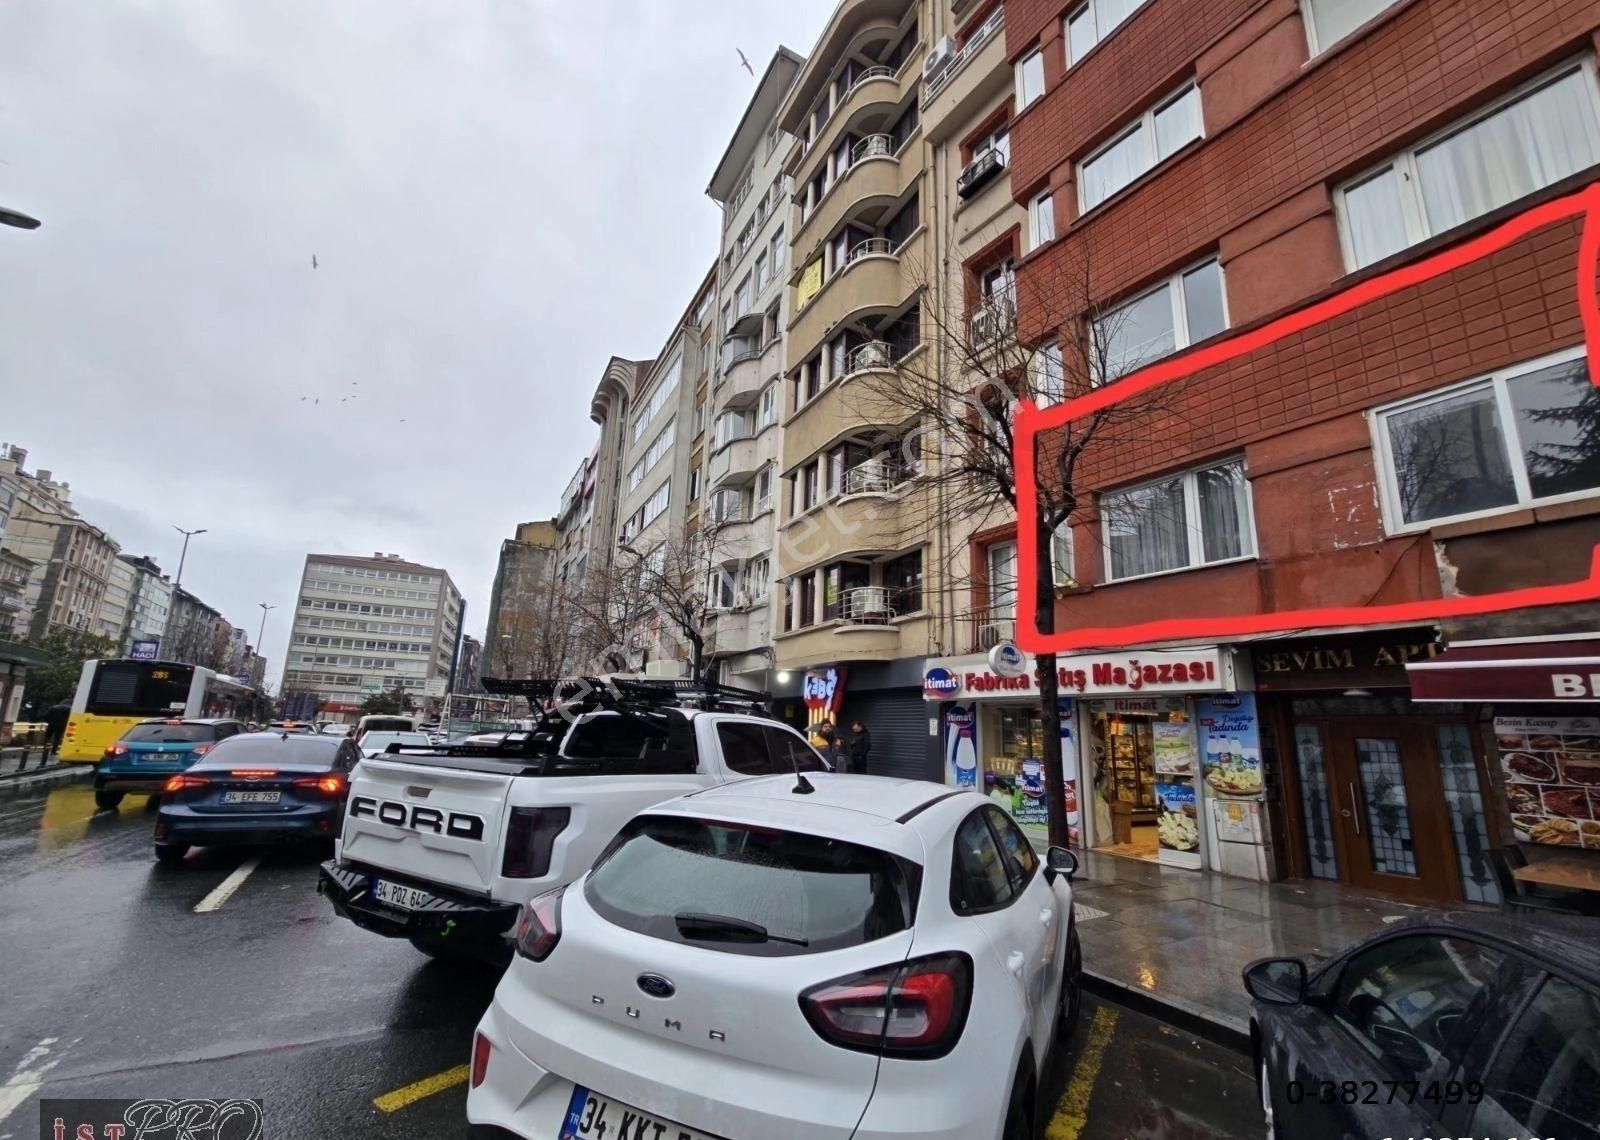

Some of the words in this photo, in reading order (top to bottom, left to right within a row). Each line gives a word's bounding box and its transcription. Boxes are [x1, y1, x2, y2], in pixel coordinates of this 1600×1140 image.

[924, 676, 957, 689] itimat
[1092, 658, 1215, 690] Mağazası
[1114, 698, 1157, 711] itimat
[946, 711, 972, 722] itimat
[225, 792, 237, 801] 34
[241, 792, 258, 801] EFE
[350, 797, 484, 841] FORD
[377, 882, 387, 899] 34
[391, 885, 408, 905] PDZ
[592, 995, 725, 1042] PUMA
[568, 1112, 580, 1126] TR
[579, 1096, 608, 1140] 34
